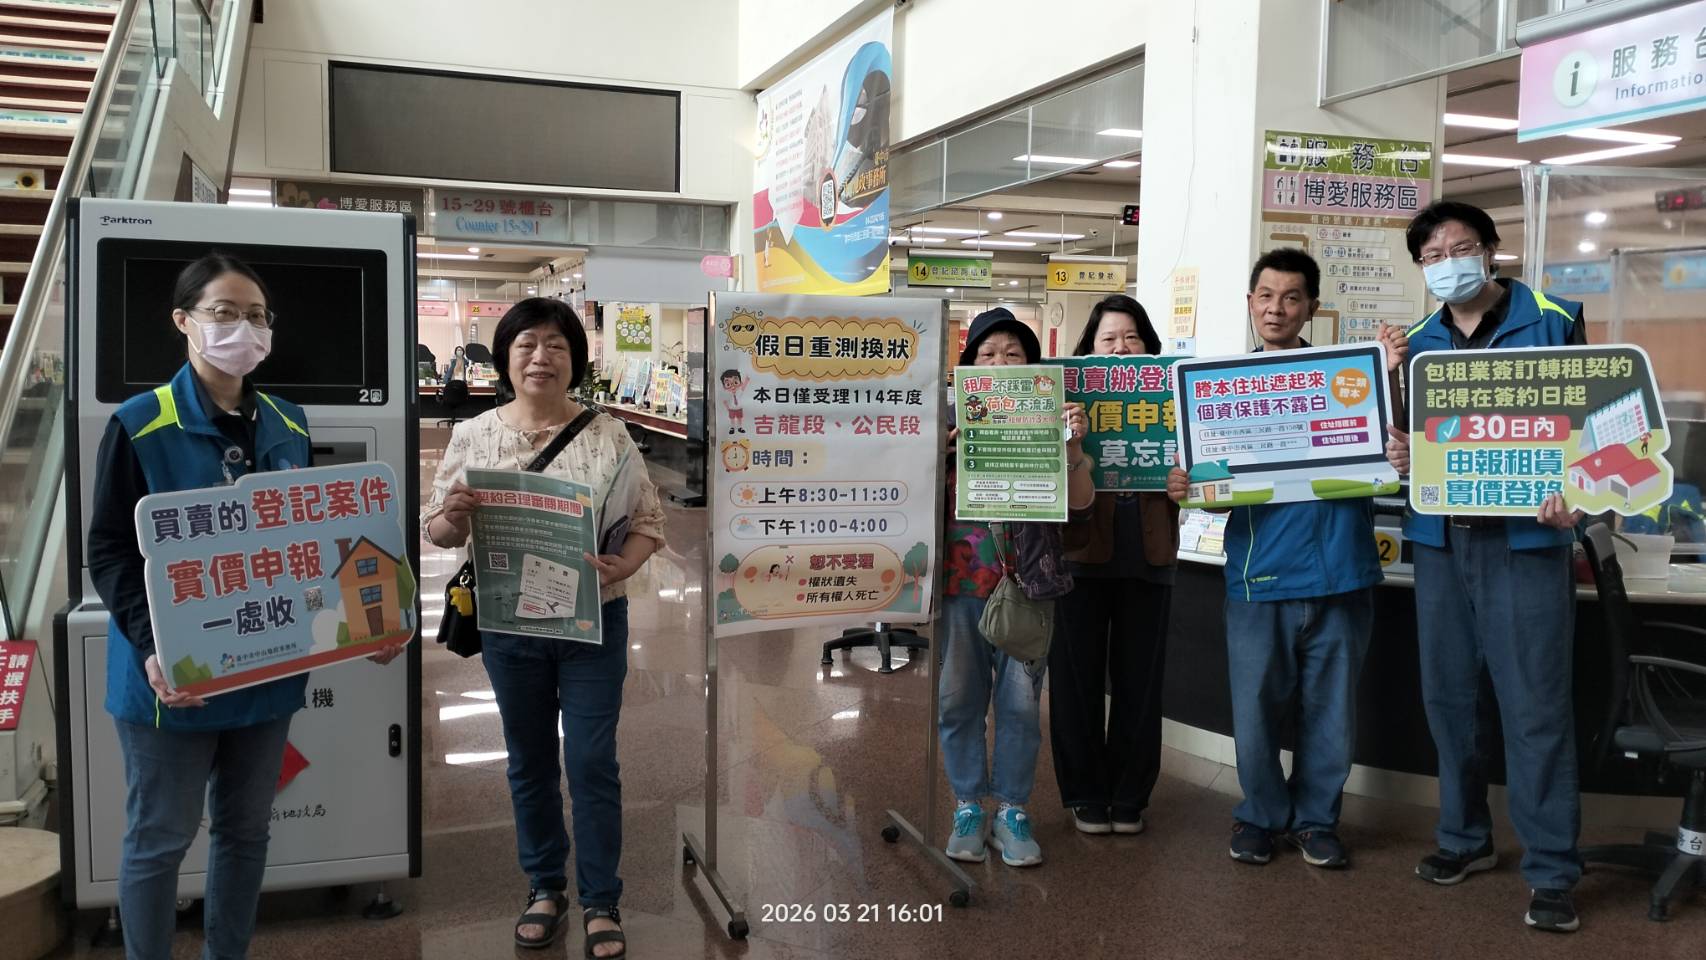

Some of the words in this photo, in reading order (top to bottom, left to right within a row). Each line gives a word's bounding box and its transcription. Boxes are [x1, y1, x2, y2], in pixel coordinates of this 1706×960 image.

[1615, 72, 1706, 100] Informatio
[1305, 139, 1418, 172] 服務台
[340, 196, 412, 213] 博愛服務區
[1303, 178, 1418, 210] 博愛服務區
[442, 197, 496, 213] 15~29
[500, 198, 554, 217] 號櫃台
[100, 216, 152, 226] Parktron
[456, 216, 498, 233] Counter
[914, 266, 927, 277] 14
[1055, 271, 1067, 282] 13
[755, 335, 910, 360] 假日重測換狀
[1064, 366, 1174, 392] 買賣辦登
[1425, 356, 1633, 382] 包租業簽訂轉租契約
[359, 389, 369, 402] 2
[962, 377, 1034, 394] 租屋不踩雷
[1194, 371, 1326, 399] 謄本住址遮起來
[753, 387, 923, 405] 本日僅受理114年度
[985, 396, 1056, 414] 荷包不流淚
[1425, 385, 1587, 408] 記得在簽約日起
[1079, 399, 1176, 432] 價申
[1196, 394, 1327, 421] 個資保護不露白
[754, 415, 921, 435] 吉龍段、公民段
[1467, 415, 1556, 440] 30日內
[1446, 449, 1564, 476] 申報租賃
[758, 487, 900, 504] 上午8:30-11:30
[151, 476, 392, 543] 買賣的登記案件
[758, 519, 888, 535] 下午1:00-4:00
[167, 540, 324, 604] 實價申報
[809, 553, 875, 570] 恕不受理
[808, 576, 858, 588] 權狀遺失
[805, 590, 880, 604] 所有權人死亡
[203, 595, 295, 636] 一處收
[0, 654, 29, 724] 請握扶手
